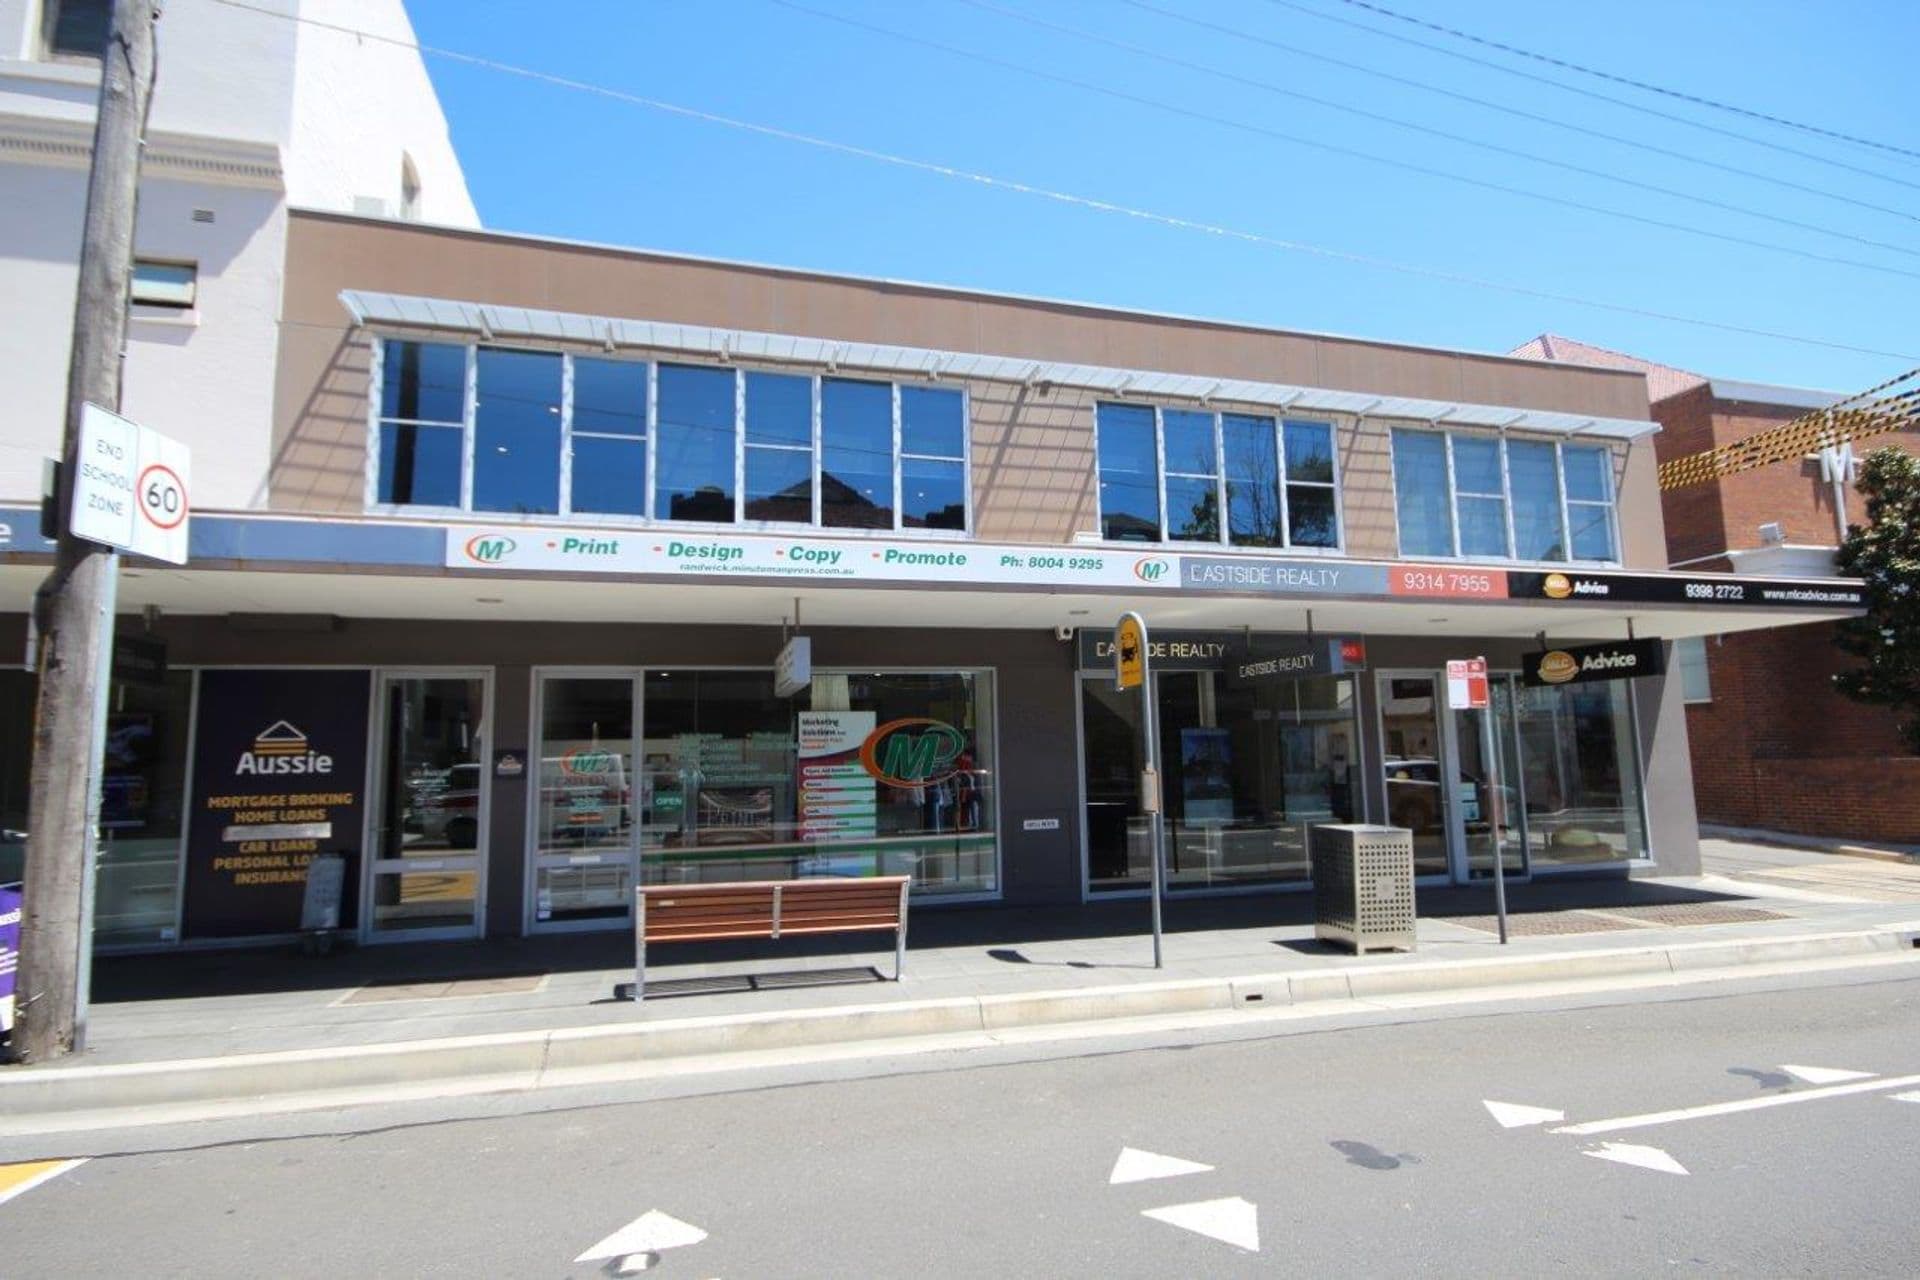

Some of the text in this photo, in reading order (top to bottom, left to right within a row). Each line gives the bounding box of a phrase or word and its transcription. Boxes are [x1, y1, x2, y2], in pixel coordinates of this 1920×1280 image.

[96, 439, 124, 460] END
[81, 463, 133, 493] SCHOOL
[87, 493, 125, 517] ZONE
[146, 482, 179, 514] 60
[562, 538, 619, 555] Print
[668, 541, 743, 560] Design
[789, 546, 842, 564] Copy
[884, 549, 967, 566] Promote
[1000, 555, 1103, 570] Ph: 8004 9295
[1190, 563, 1340, 587] EASTSIDE REALTY
[1404, 572, 1489, 592] 9314 7955
[1574, 581, 1608, 594] Advice
[1716, 585, 1743, 599] 2722
[1170, 643, 1225, 658] REALTY
[1239, 655, 1315, 678] EASTSIDE REALTY
[1582, 651, 1637, 671] Advice
[235, 750, 333, 775] Aussie
[207, 793, 353, 809] MORTGAGE BROKING
[234, 808, 327, 823] HOME LOANS
[238, 839, 317, 853] CAR LOANS
[213, 856, 290, 870] PERSONAL
